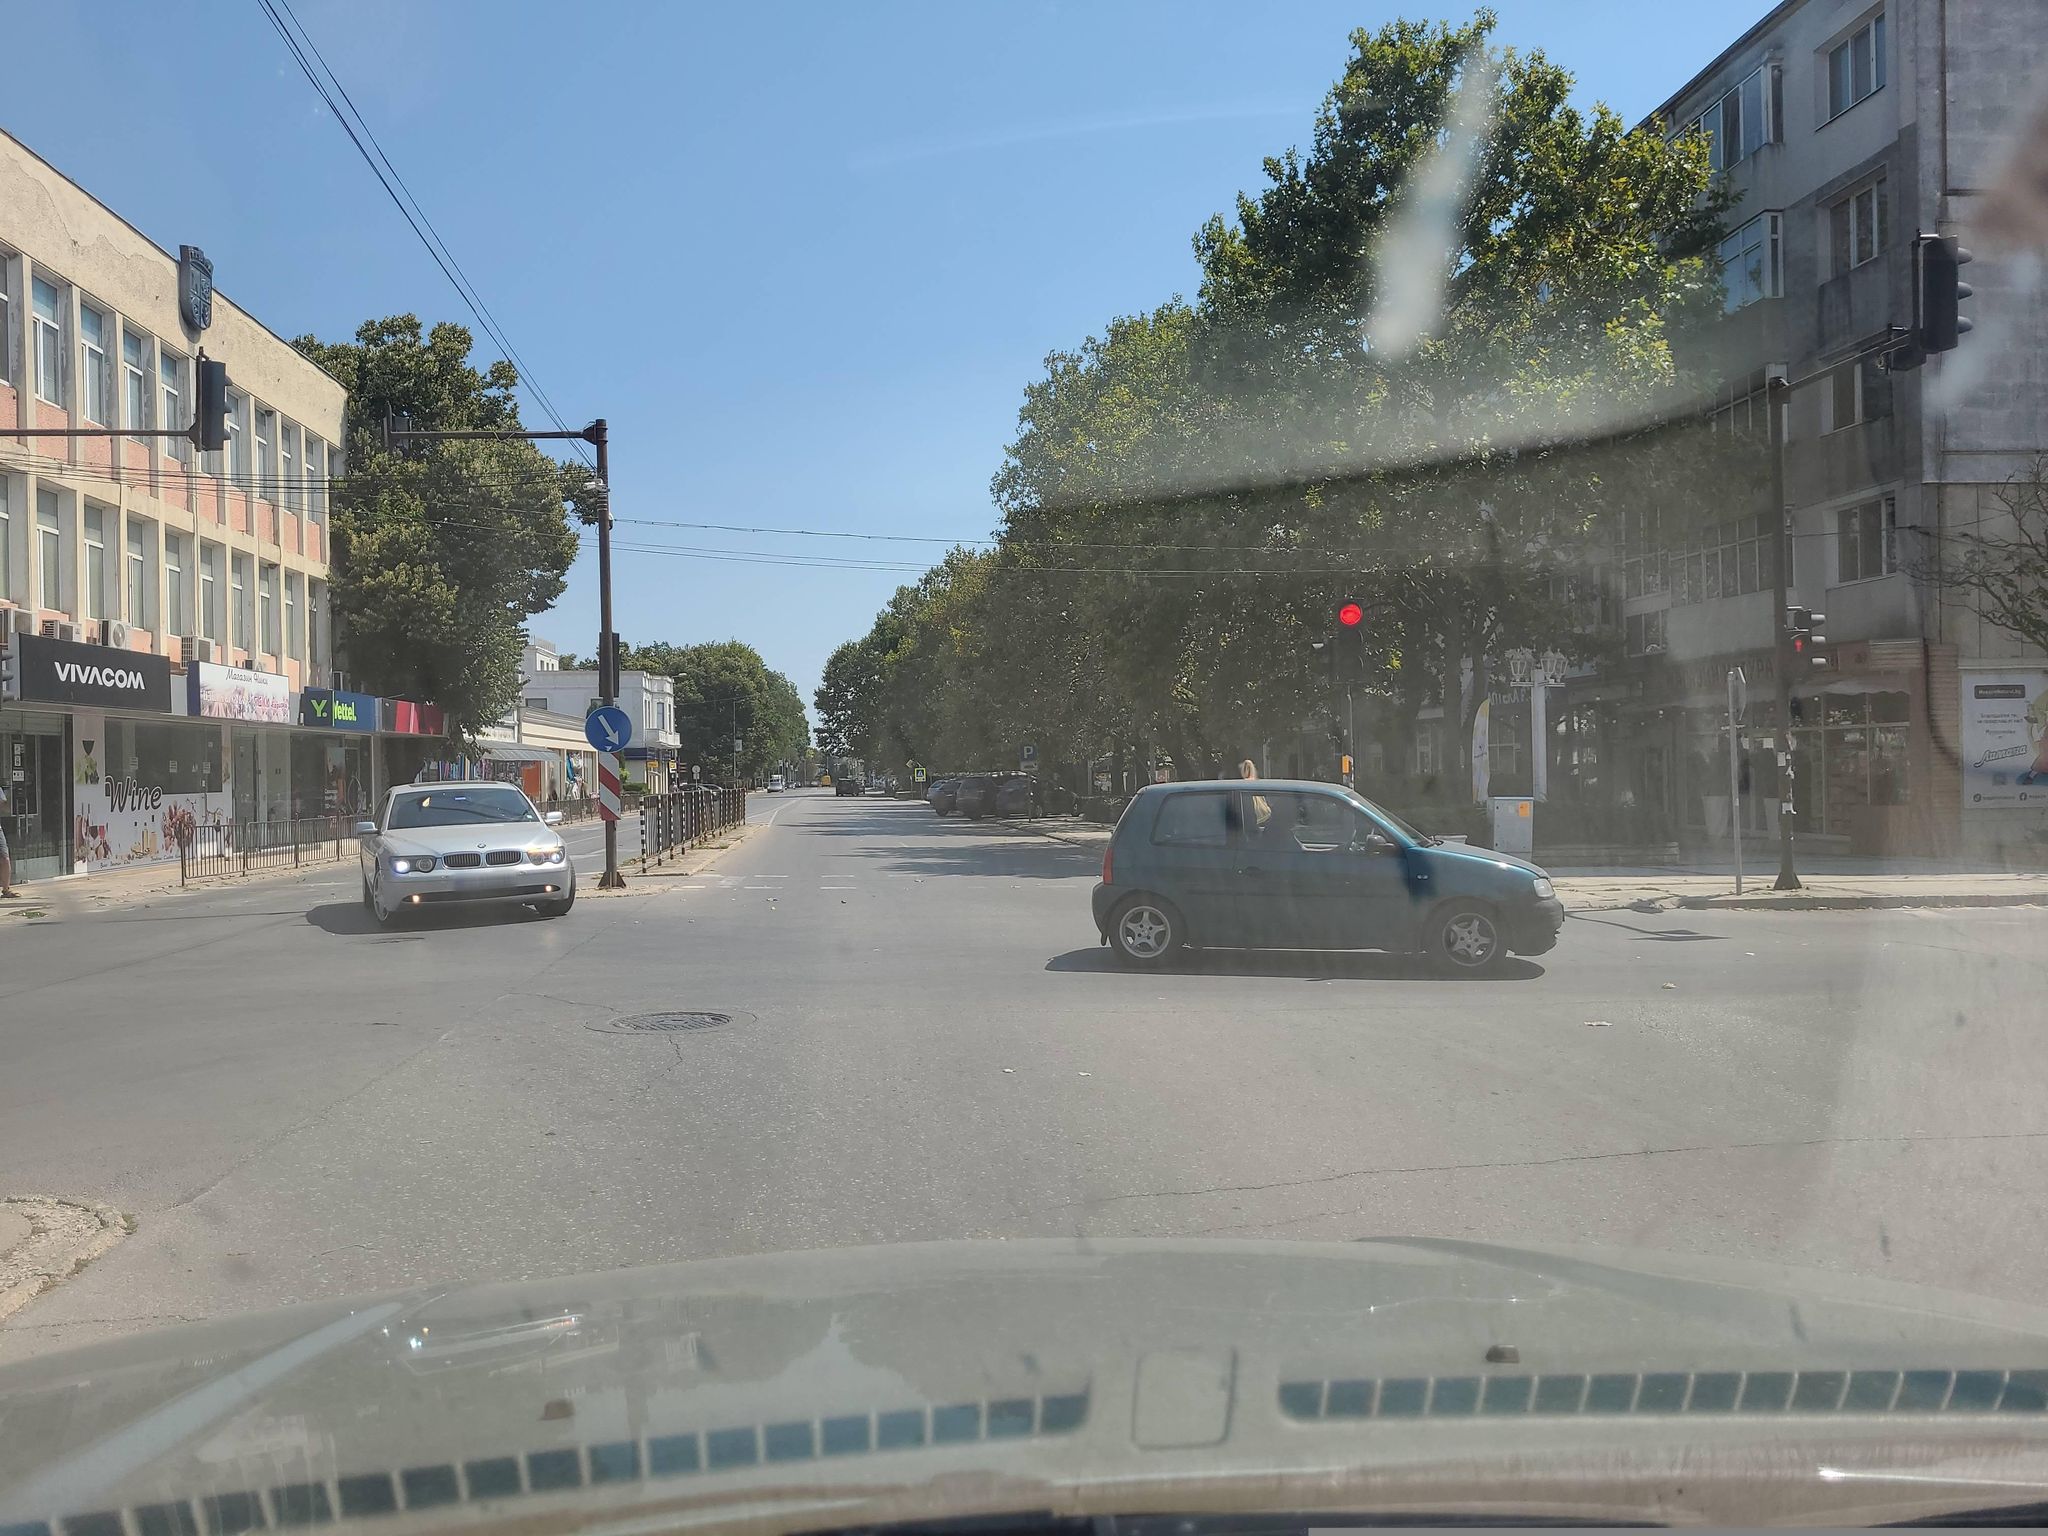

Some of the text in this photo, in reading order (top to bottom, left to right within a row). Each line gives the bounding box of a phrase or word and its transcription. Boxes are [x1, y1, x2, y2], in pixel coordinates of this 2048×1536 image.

[54, 661, 146, 690] VIVACOM
[1023, 745, 1034, 759] P
[105, 775, 163, 813] Wine
